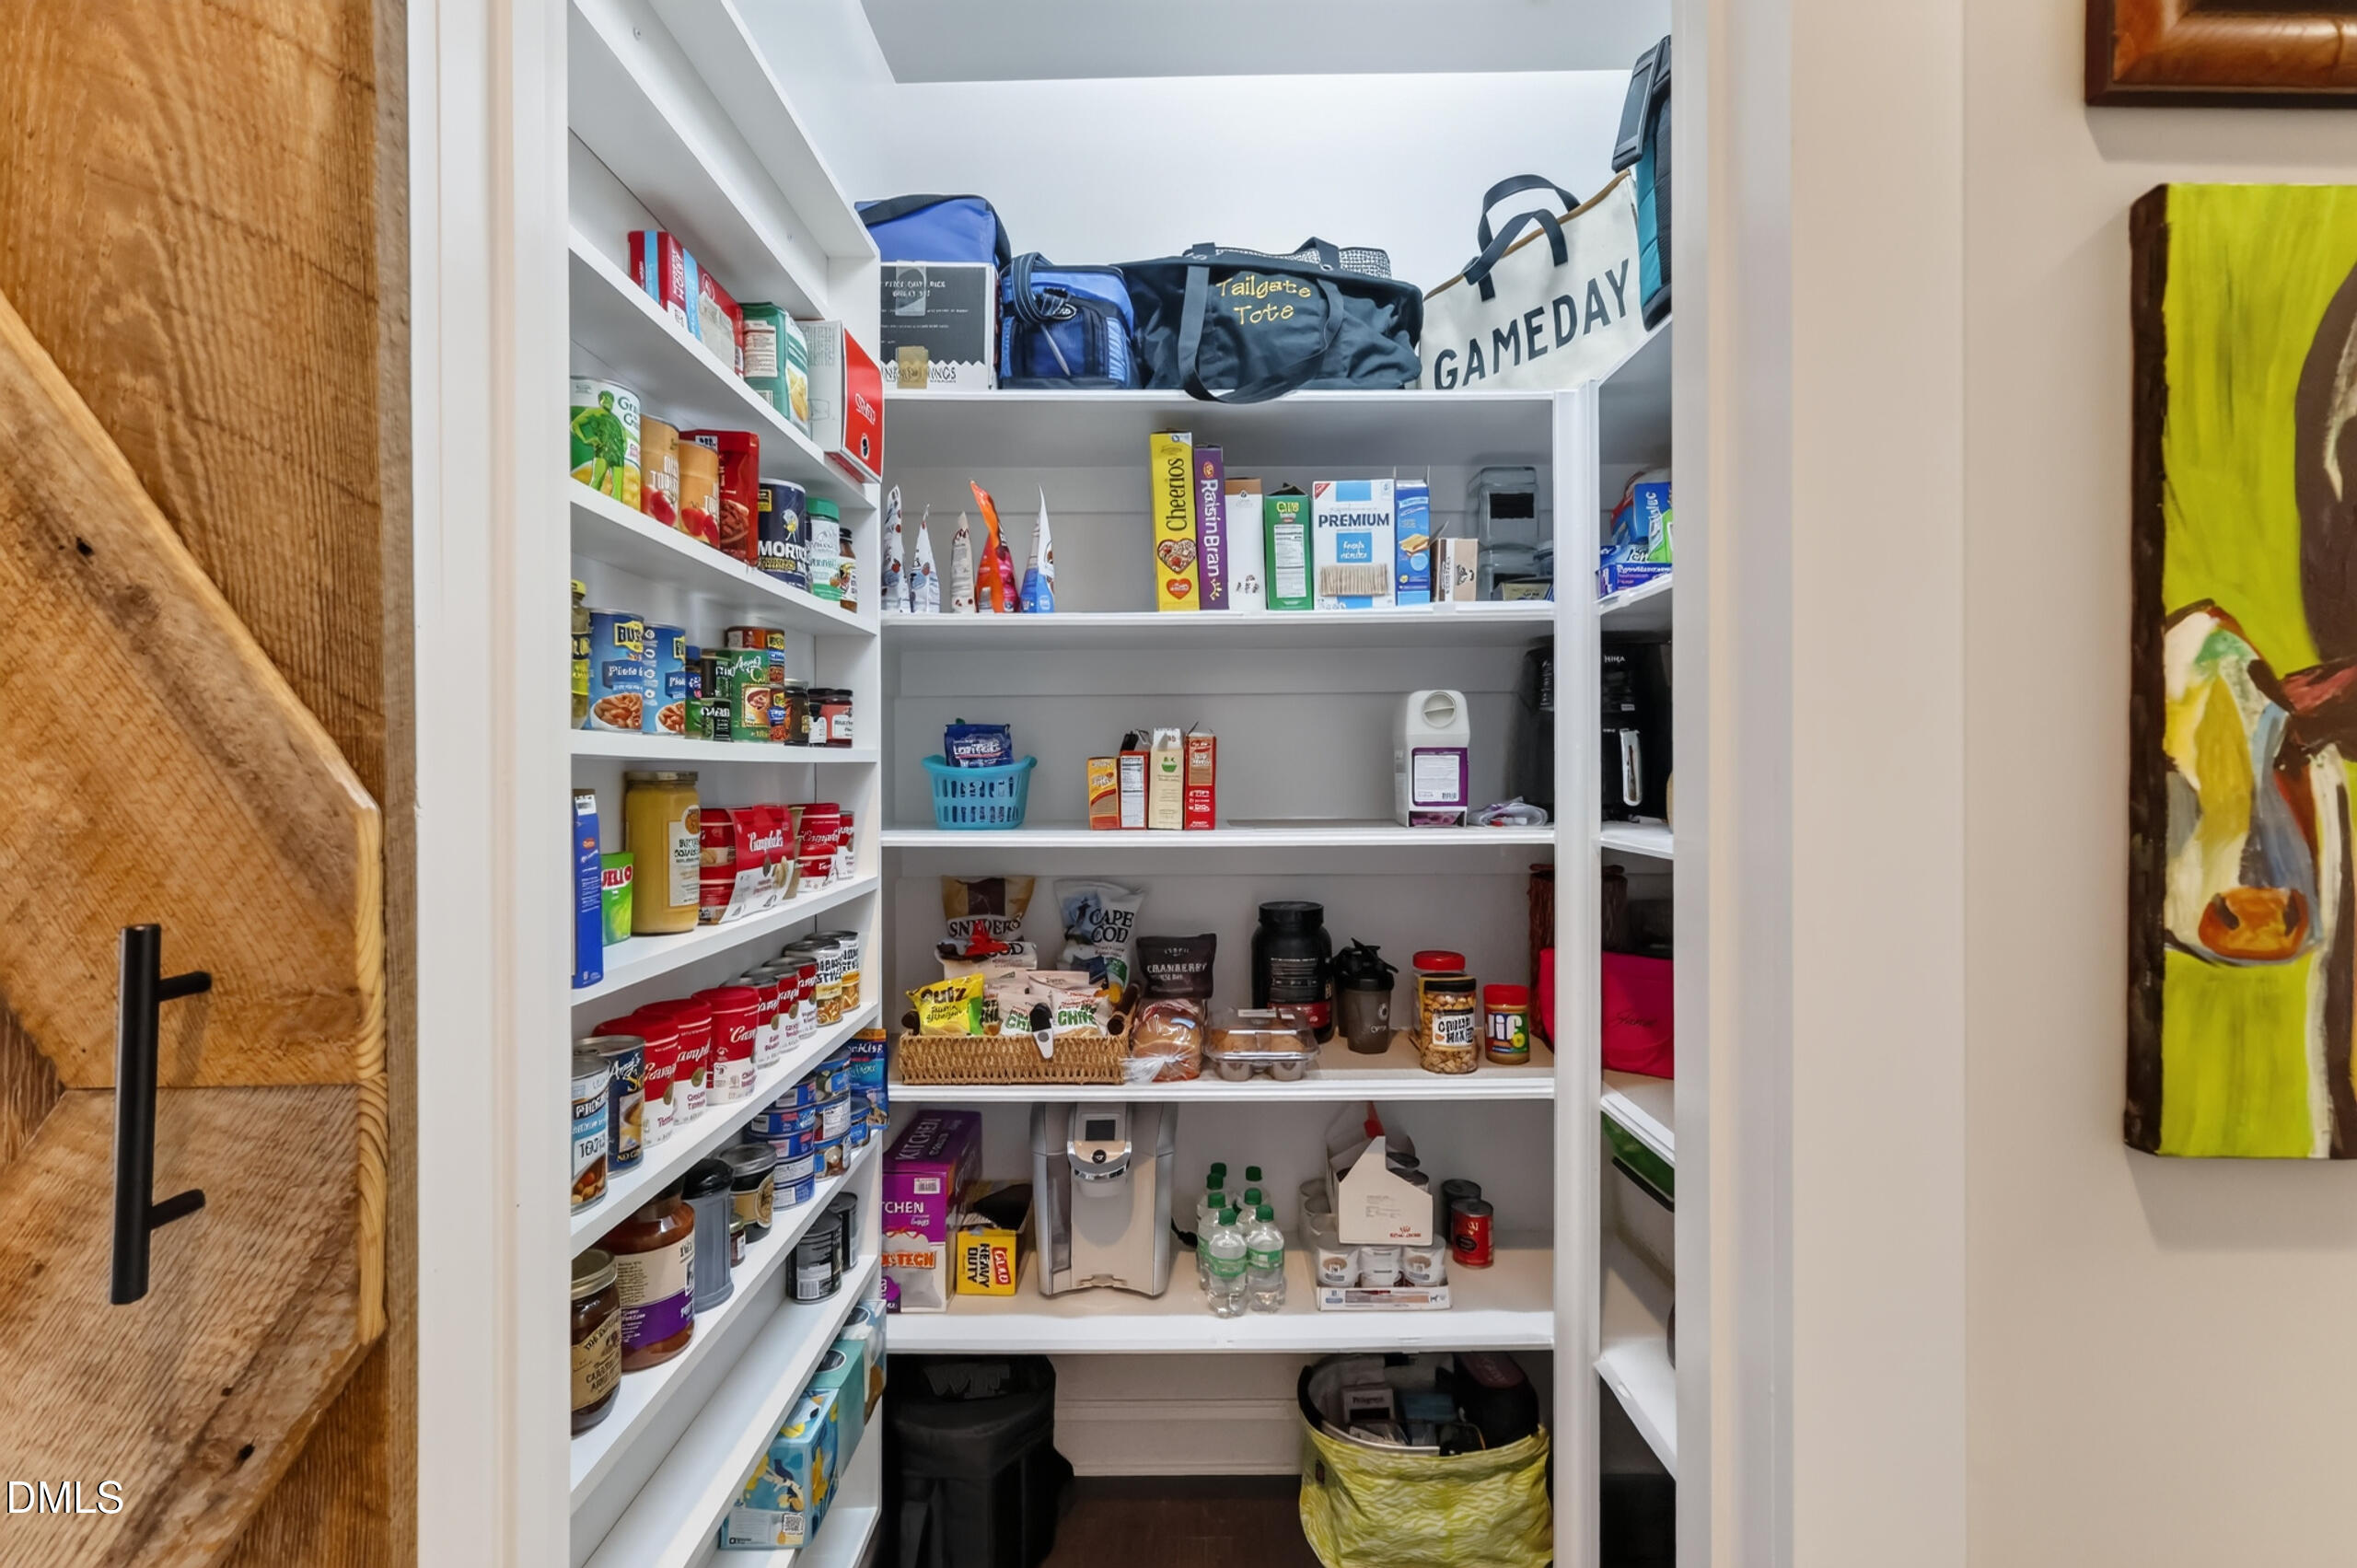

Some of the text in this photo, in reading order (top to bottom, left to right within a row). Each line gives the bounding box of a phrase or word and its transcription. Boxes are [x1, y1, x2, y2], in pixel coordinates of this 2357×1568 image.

[1215, 277, 1312, 299] Tailgate
[1233, 302, 1295, 326] Tote
[1434, 258, 1630, 390] GAMEDAY
[1166, 458, 1188, 531] Cheerios
[1201, 479, 1221, 577] Raisin Bran
[1318, 513, 1390, 528] PREMIUM
[1089, 908, 1135, 928] CAPE
[1091, 924, 1129, 943] COD
[1488, 1015, 1523, 1041] Jif
[881, 1201, 924, 1214] CHEN
[968, 1247, 979, 1283] DUTY
[979, 1243, 990, 1288] HEAVY
